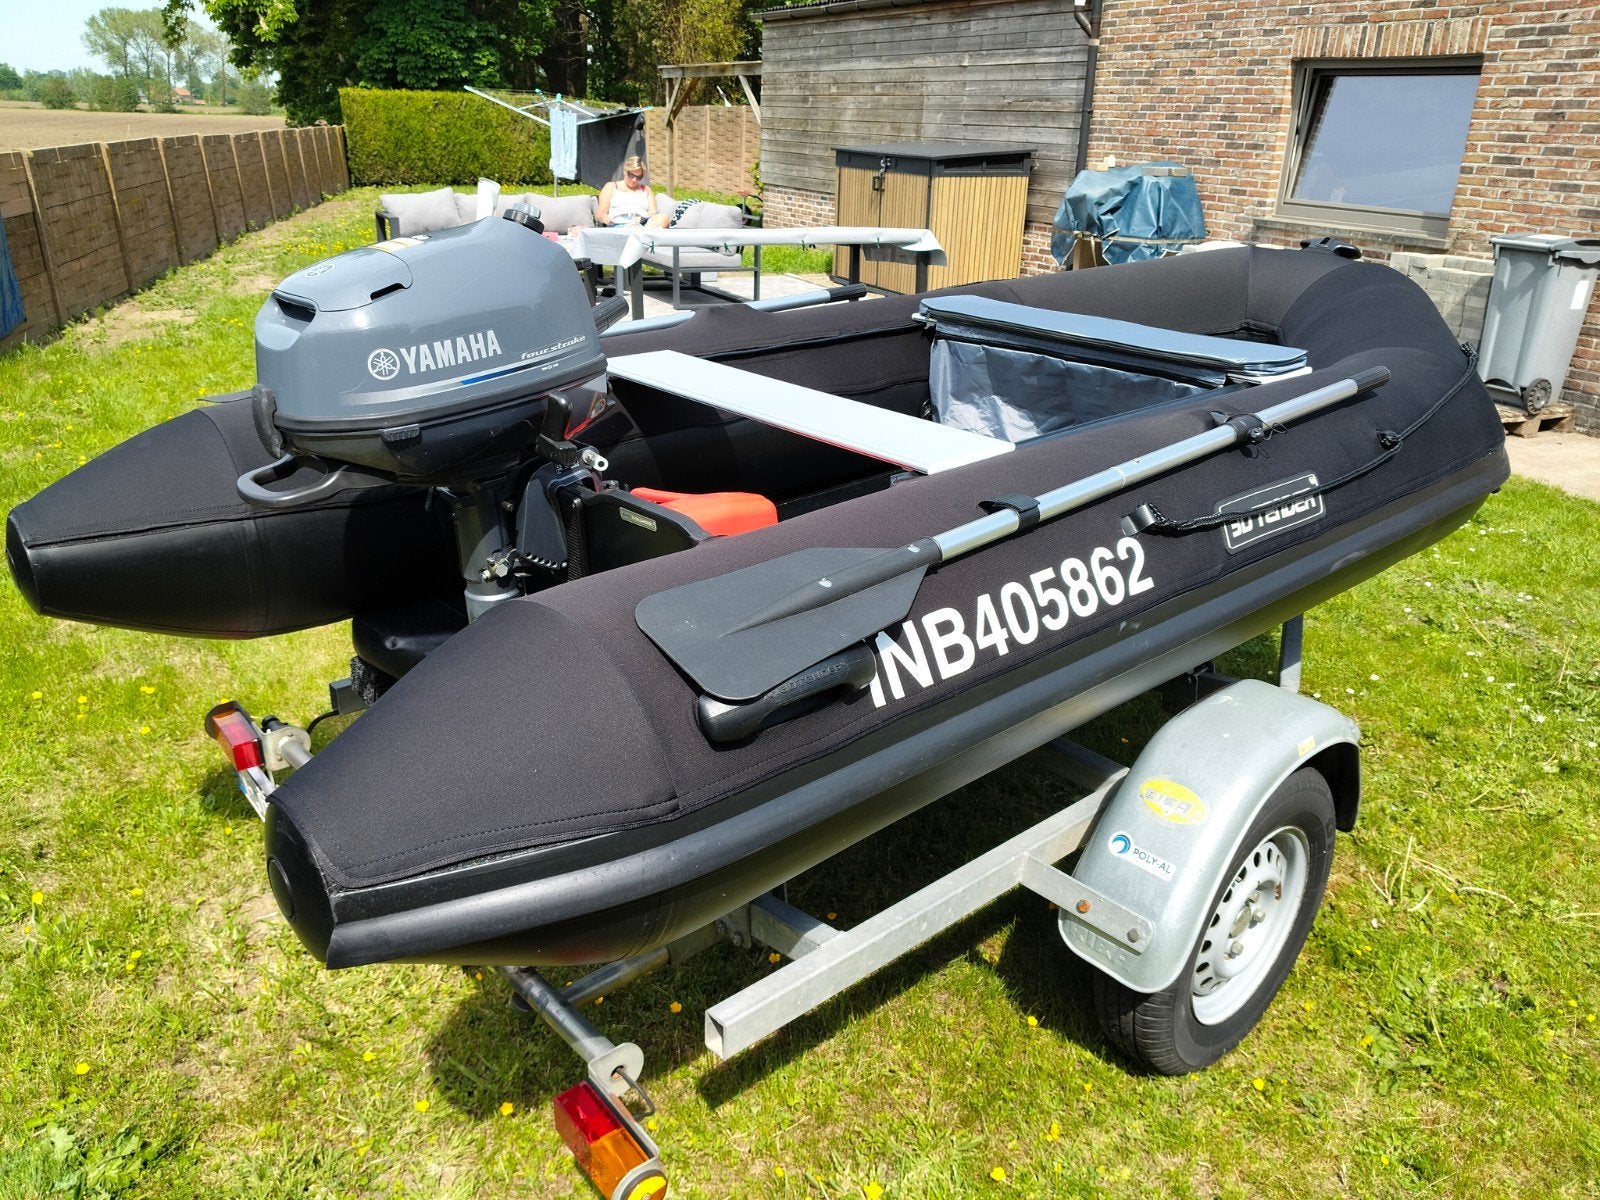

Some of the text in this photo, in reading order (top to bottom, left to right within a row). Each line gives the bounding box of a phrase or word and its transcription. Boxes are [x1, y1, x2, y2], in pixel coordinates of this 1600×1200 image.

[400, 329, 502, 374] YAMAHA
[521, 335, 586, 360] four stroke
[1133, 848, 1171, 874] POLY-AL
